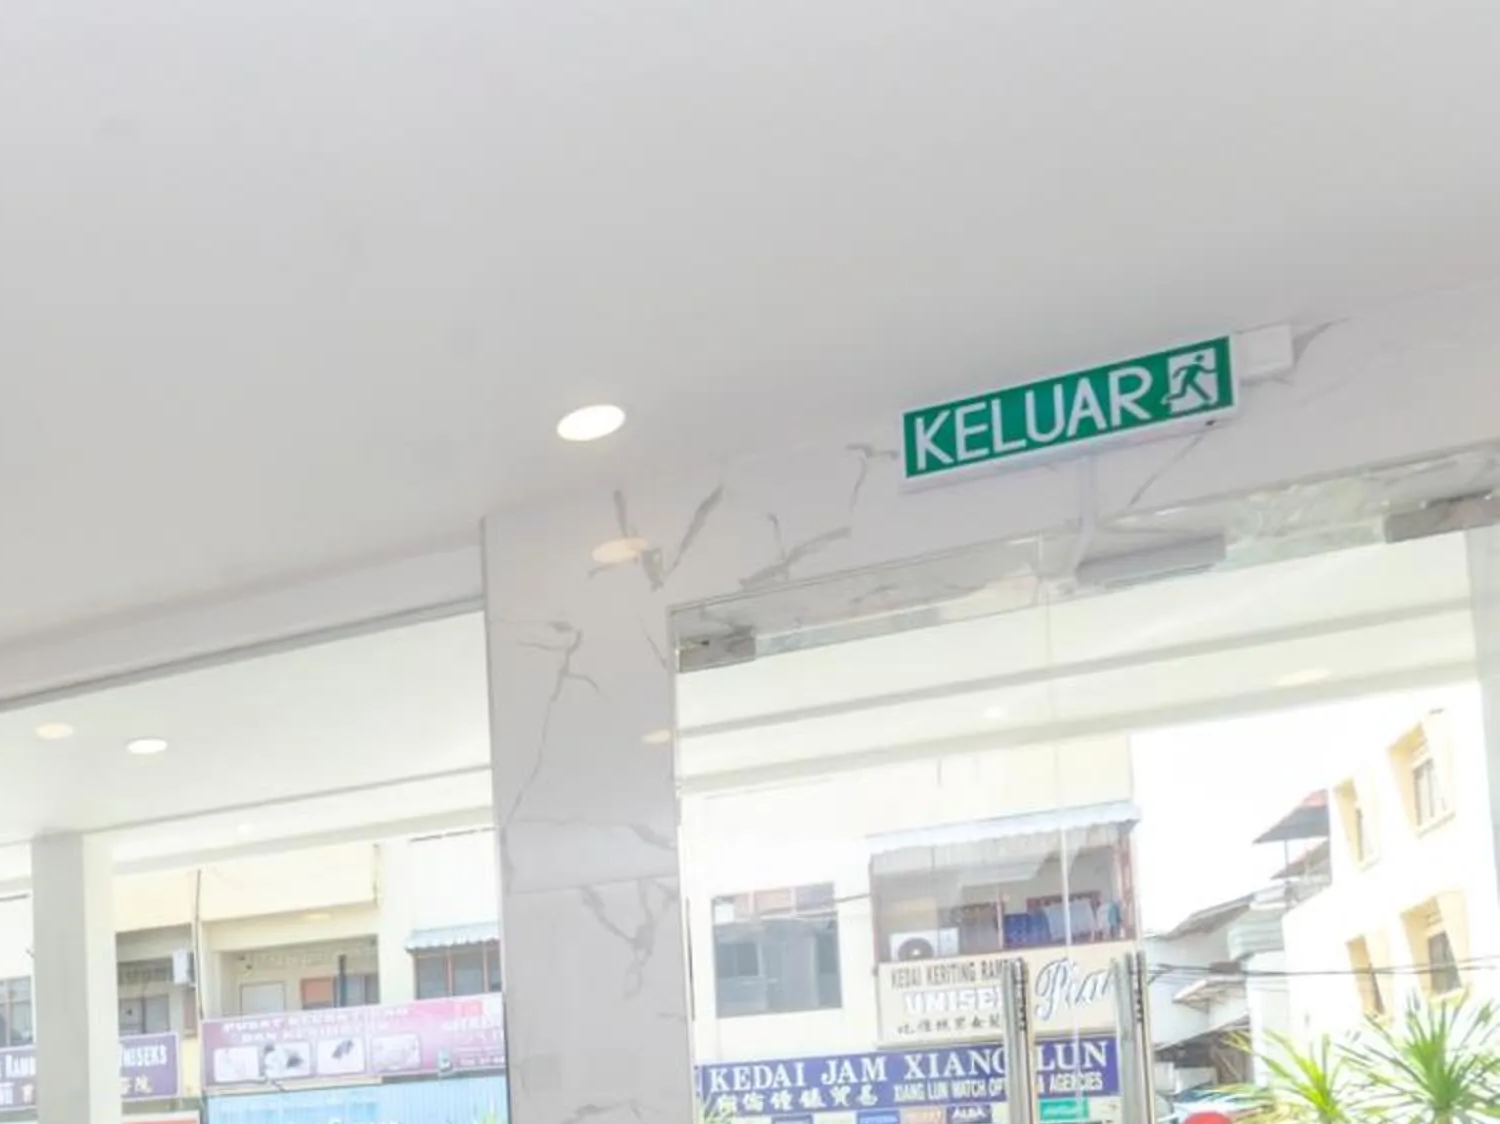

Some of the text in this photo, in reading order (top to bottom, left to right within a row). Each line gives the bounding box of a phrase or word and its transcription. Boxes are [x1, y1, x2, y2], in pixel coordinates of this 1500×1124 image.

[914, 365, 1153, 471] KELUAR
[891, 966, 921, 990] KEDAI
[904, 985, 1000, 1015] UNISE
[708, 1062, 806, 1092] KEDAI
[820, 1055, 889, 1086] JAM
[1037, 1040, 1108, 1071] LUN
[894, 1081, 926, 1102] XIANG
[928, 1080, 949, 1100] LUN
[952, 1078, 988, 1098] WATCH
